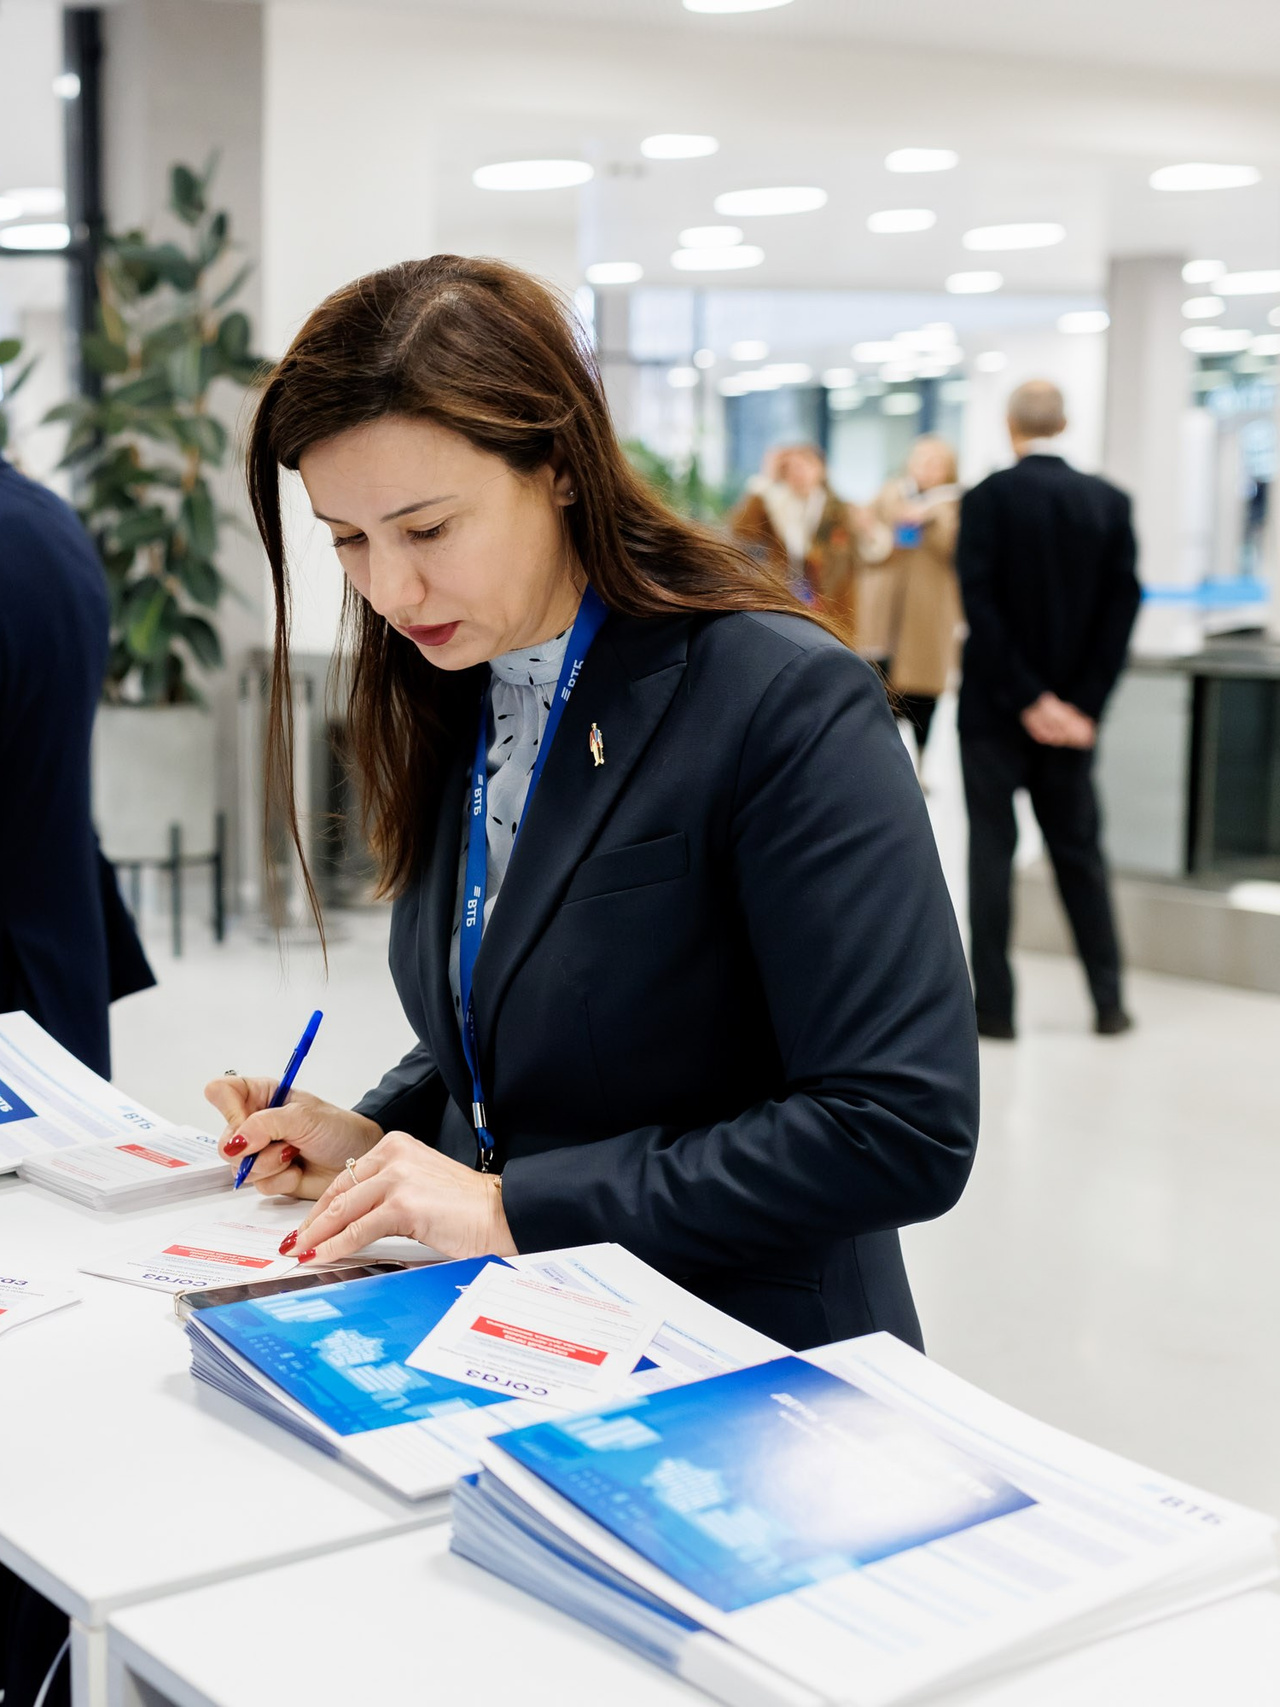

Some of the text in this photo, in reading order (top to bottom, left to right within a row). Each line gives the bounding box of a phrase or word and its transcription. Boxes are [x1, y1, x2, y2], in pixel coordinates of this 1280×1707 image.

[473, 787, 483, 816] ВТБ
[466, 899, 478, 928] ВТБ
[122, 1112, 156, 1130] ВТБ
[142, 1273, 208, 1288] согаз
[465, 1368, 549, 1397] согаз
[1158, 1495, 1226, 1526] ВТБ
